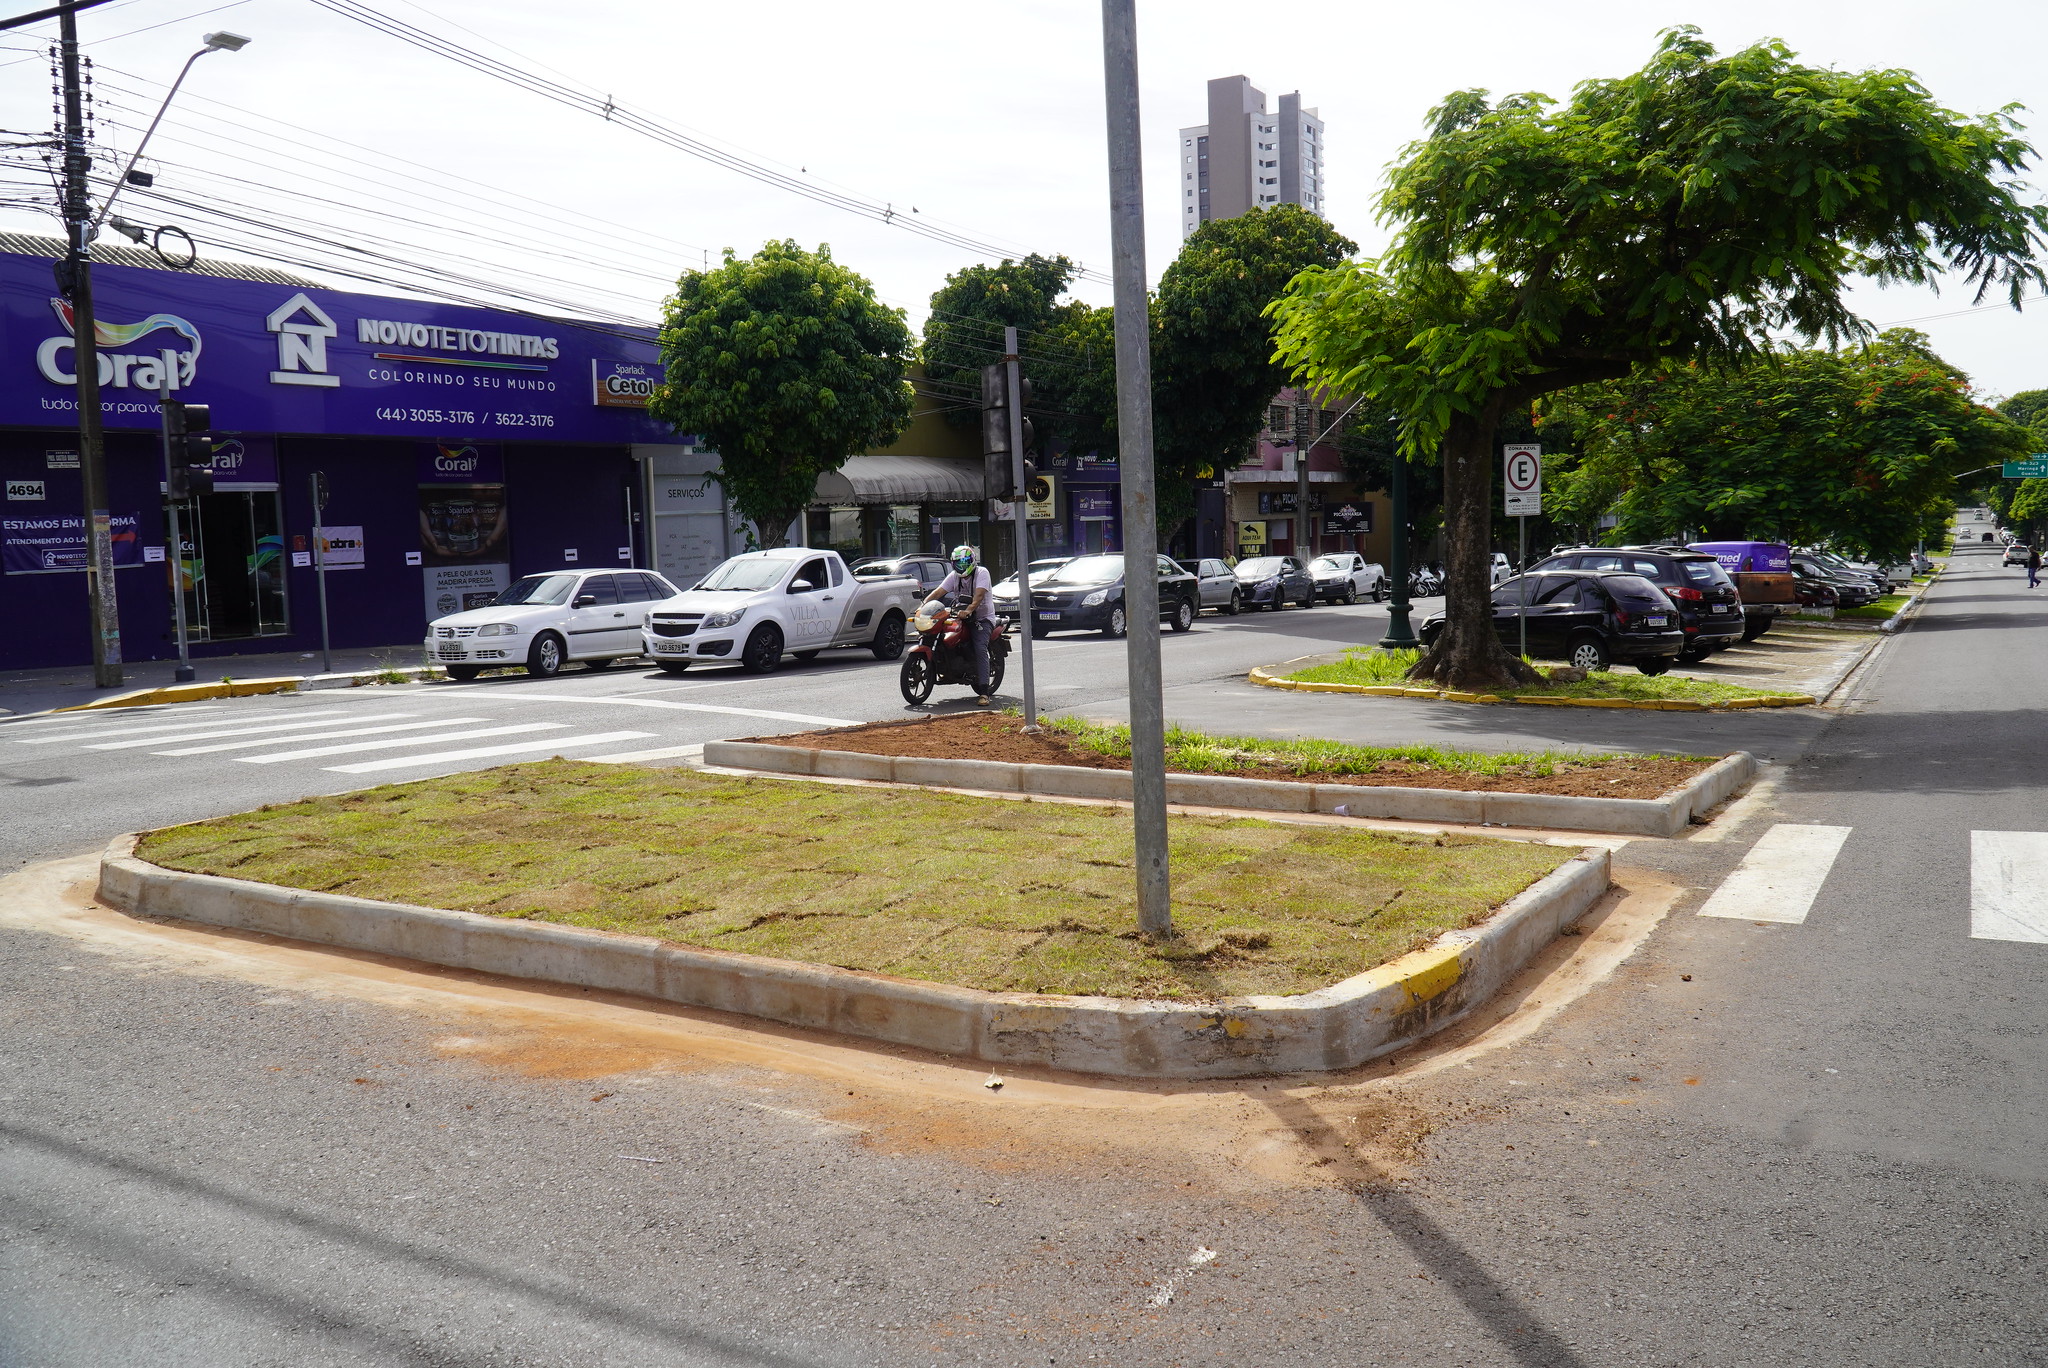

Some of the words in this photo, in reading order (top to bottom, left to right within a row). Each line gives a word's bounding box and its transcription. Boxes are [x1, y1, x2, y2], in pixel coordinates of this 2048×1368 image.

[358, 318, 560, 359] NOVOTETOTINTAS
[616, 364, 646, 375] Sparlack
[368, 369, 465, 386] COLORINDO
[474, 376, 500, 388] SEU
[508, 378, 556, 392] MUNDO
[607, 375, 654, 395] Cetol
[42, 398, 72, 410] tudo
[118, 403, 147, 414] para
[376, 408, 407, 421] (44)
[410, 409, 475, 423] 3055-3176
[496, 413, 554, 426] 3622-3176
[435, 456, 472, 471] Coral
[1052, 456, 1067, 466] Coral
[1518, 461, 1528, 481] E
[9, 485, 43, 495] 4694
[668, 488, 704, 499] SERVIÇOS
[3, 520, 59, 529] ESTAMOS
[62, 519, 78, 528] EM
[1242, 545, 1260, 553] WU
[790, 606, 820, 621] VILLA
[796, 620, 832, 637] DECOR
